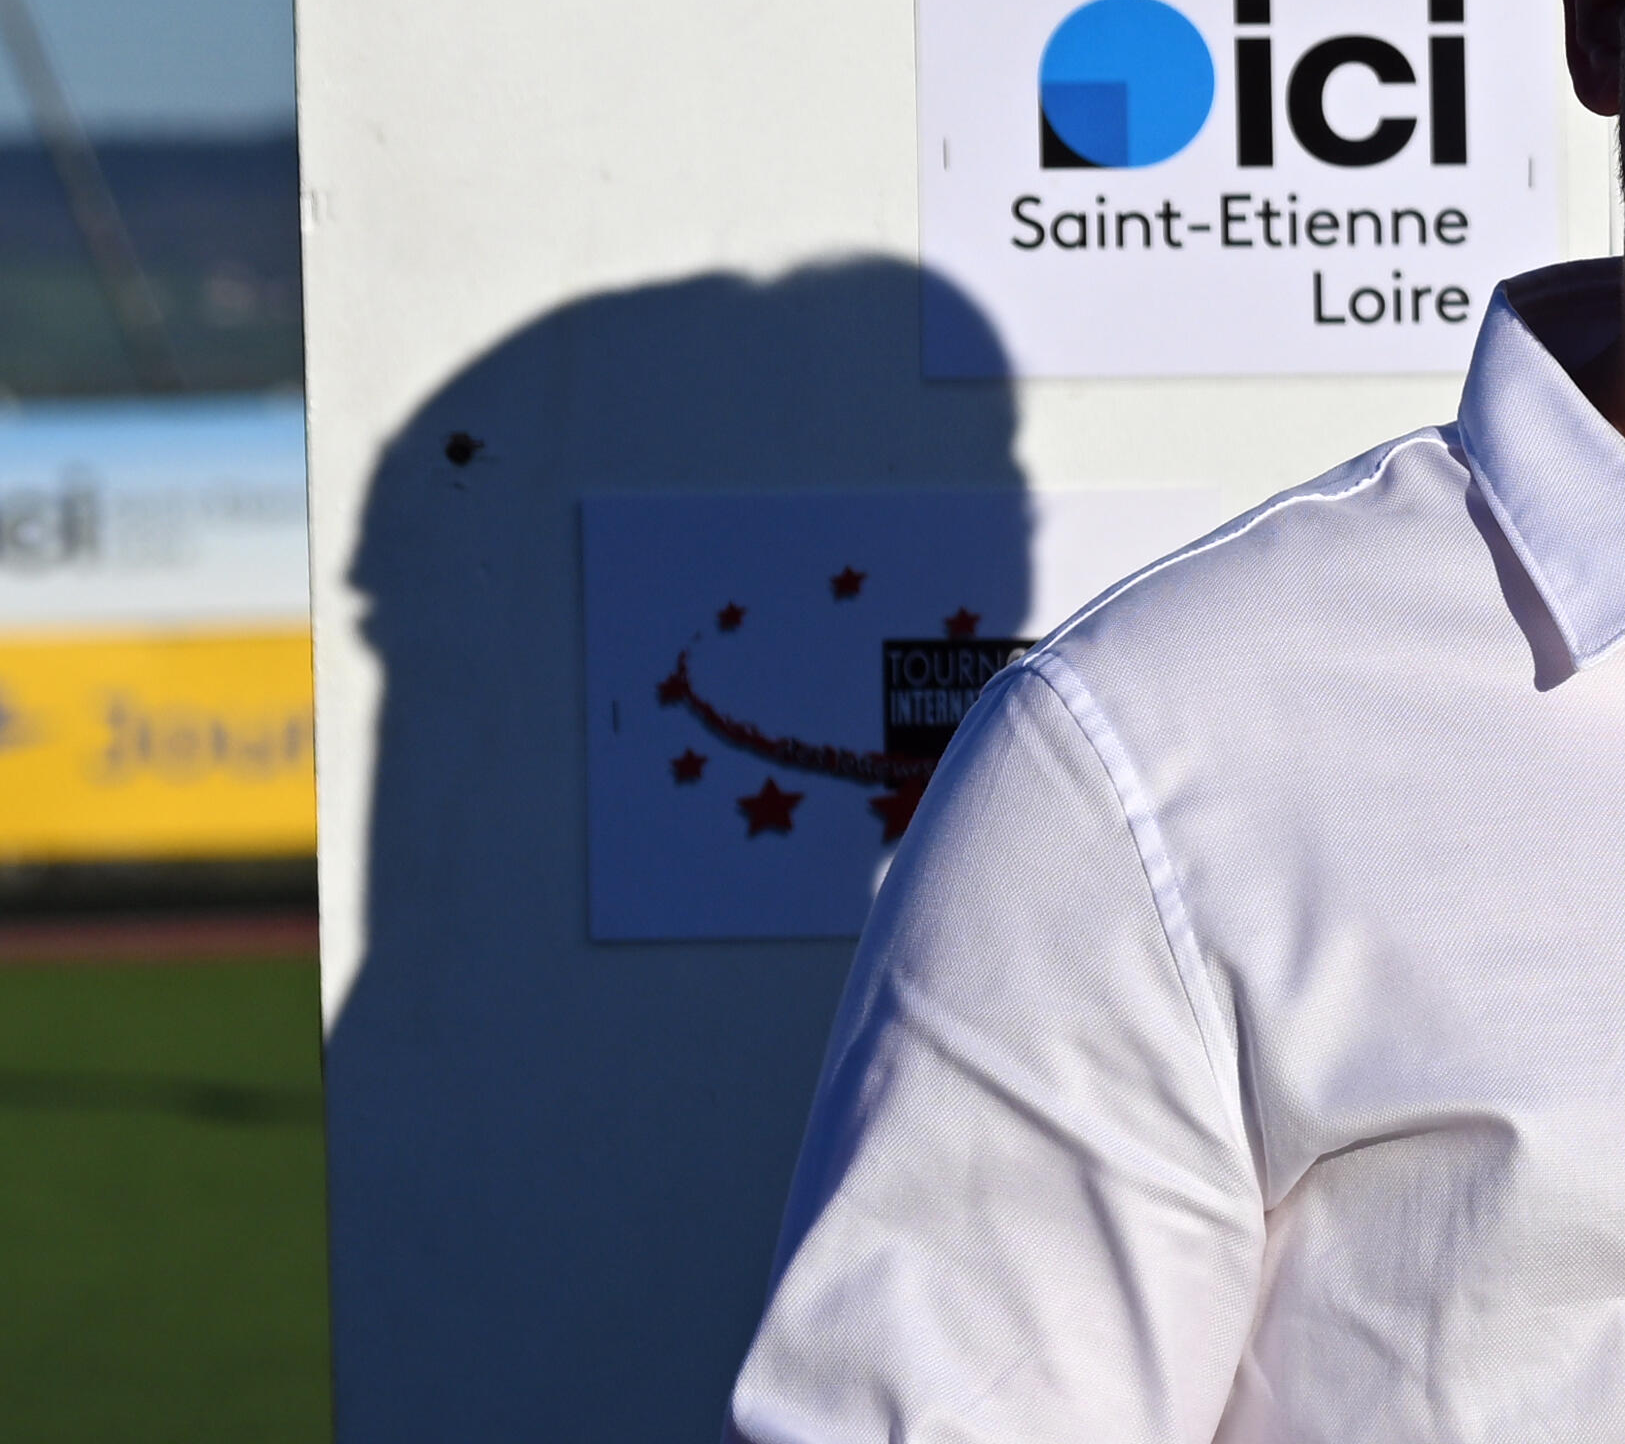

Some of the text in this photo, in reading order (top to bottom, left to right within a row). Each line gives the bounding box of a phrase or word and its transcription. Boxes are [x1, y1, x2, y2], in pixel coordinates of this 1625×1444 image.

[1010, 193, 1470, 250] Saint-Etienne
[1313, 270, 1471, 326] Loire
[888, 648, 1022, 687] TOURN
